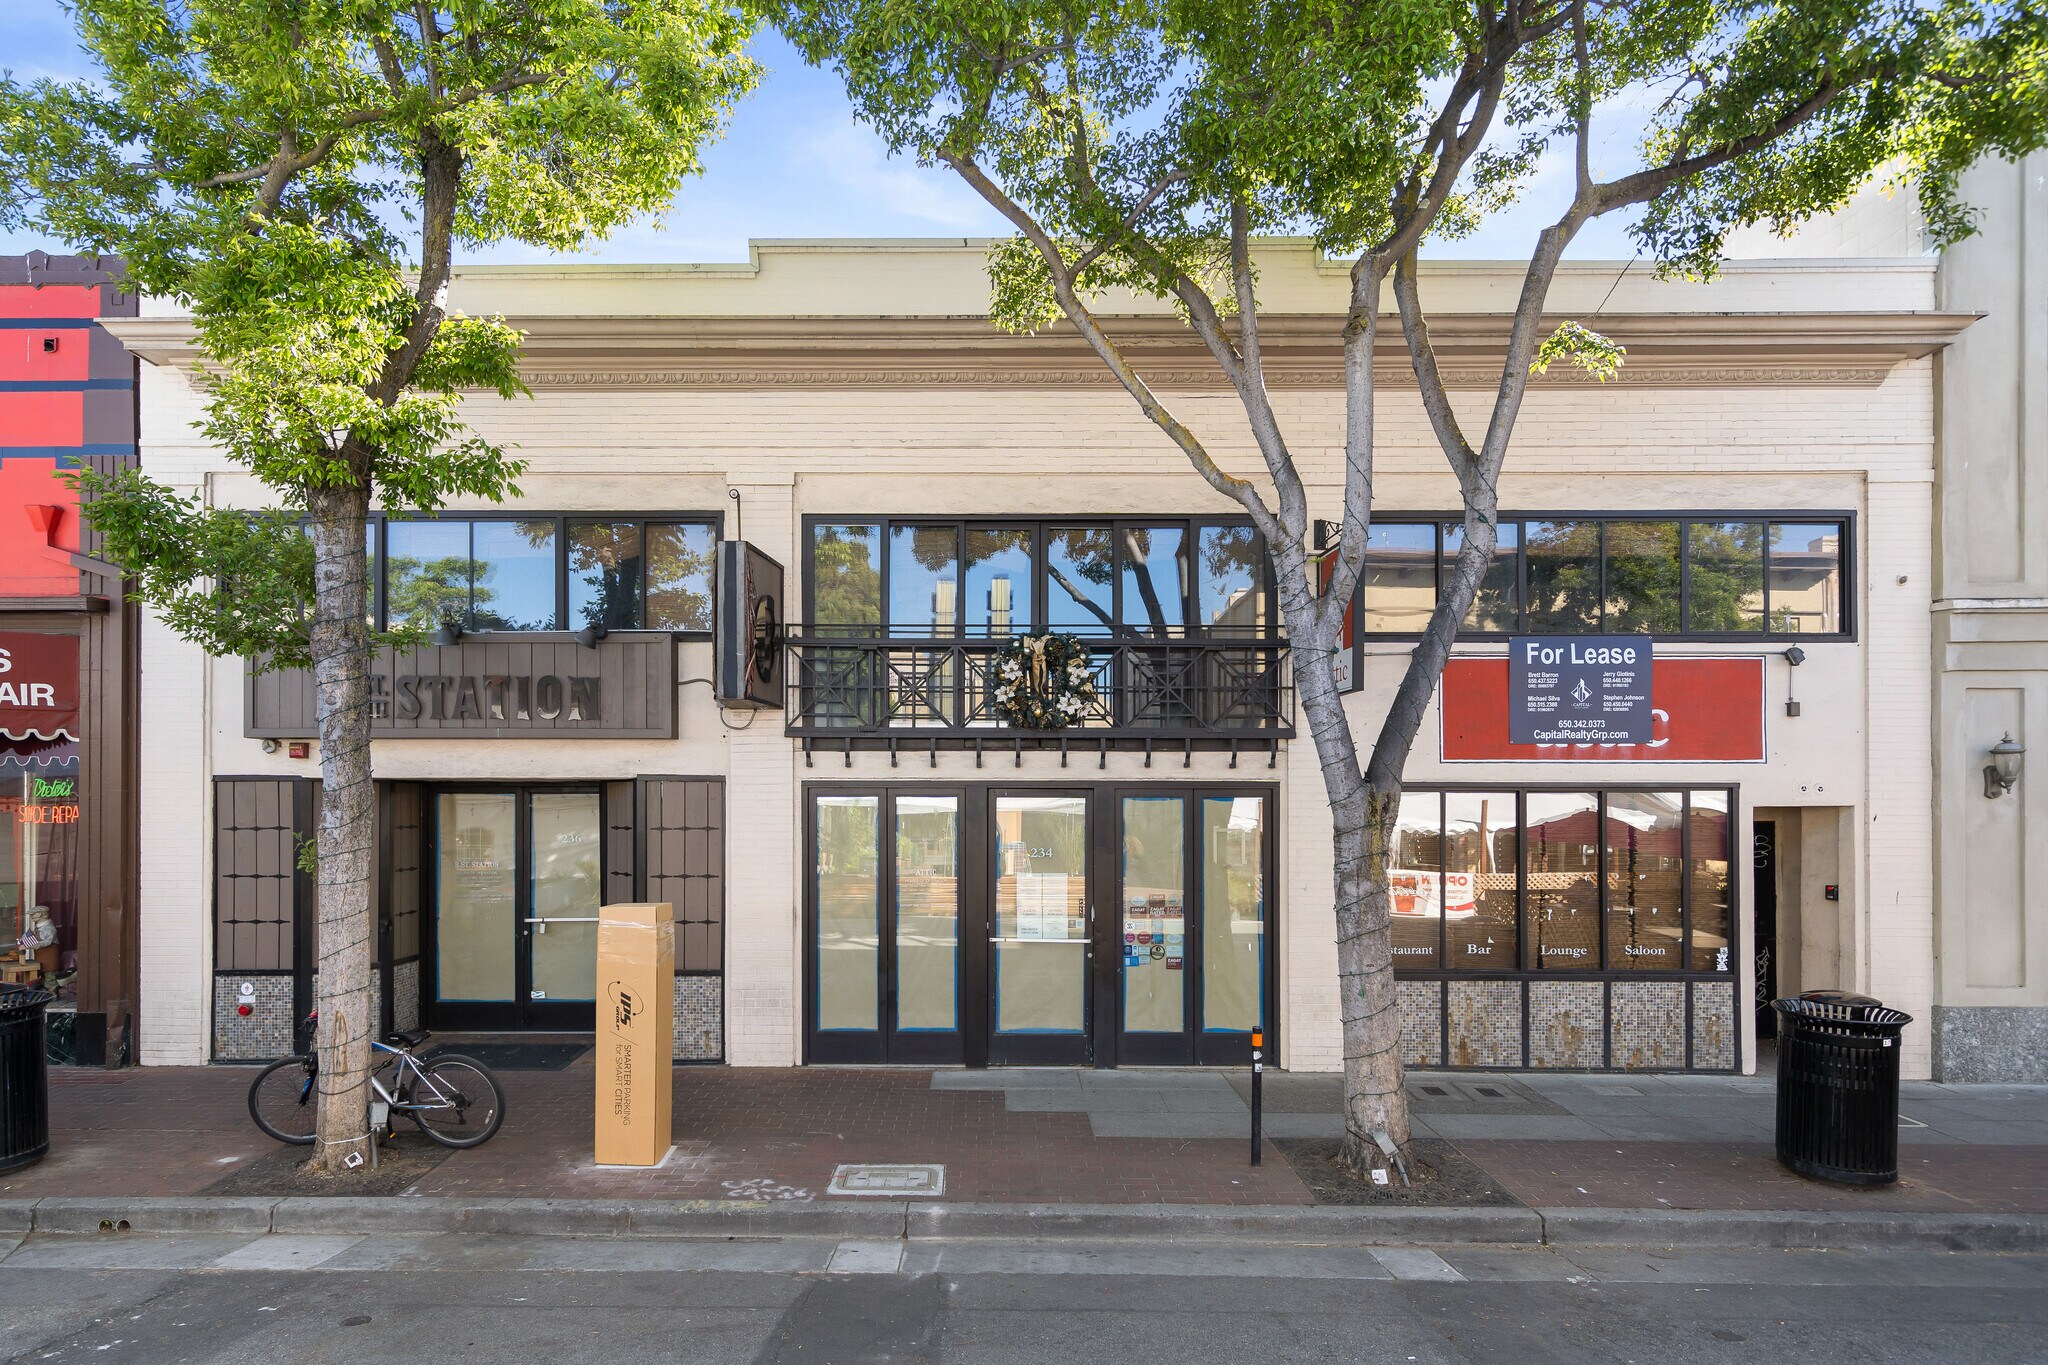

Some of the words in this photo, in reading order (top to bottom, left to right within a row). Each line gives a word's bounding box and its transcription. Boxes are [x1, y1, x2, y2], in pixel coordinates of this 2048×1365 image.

[1526, 643, 1564, 664] For
[1570, 643, 1636, 664] Lease
[1603, 671, 1615, 679] Jerry
[396, 675, 600, 720] STATION
[1558, 719, 1606, 728] 650.342.0373
[1533, 729, 1629, 741] CapitalRealtyGrp.com
[18, 805, 49, 823] SHOE
[561, 833, 582, 844] 236
[1030, 847, 1053, 858] 234
[915, 868, 937, 876] ATTIC
[1467, 943, 1491, 955] Bar
[1540, 944, 1588, 958] Lounge
[1625, 944, 1666, 956] Saloon
[615, 1044, 623, 1055] for
[624, 1044, 632, 1086] SMARTER
[615, 1057, 623, 1087] SMART
[623, 1087, 631, 1126] PARKING
